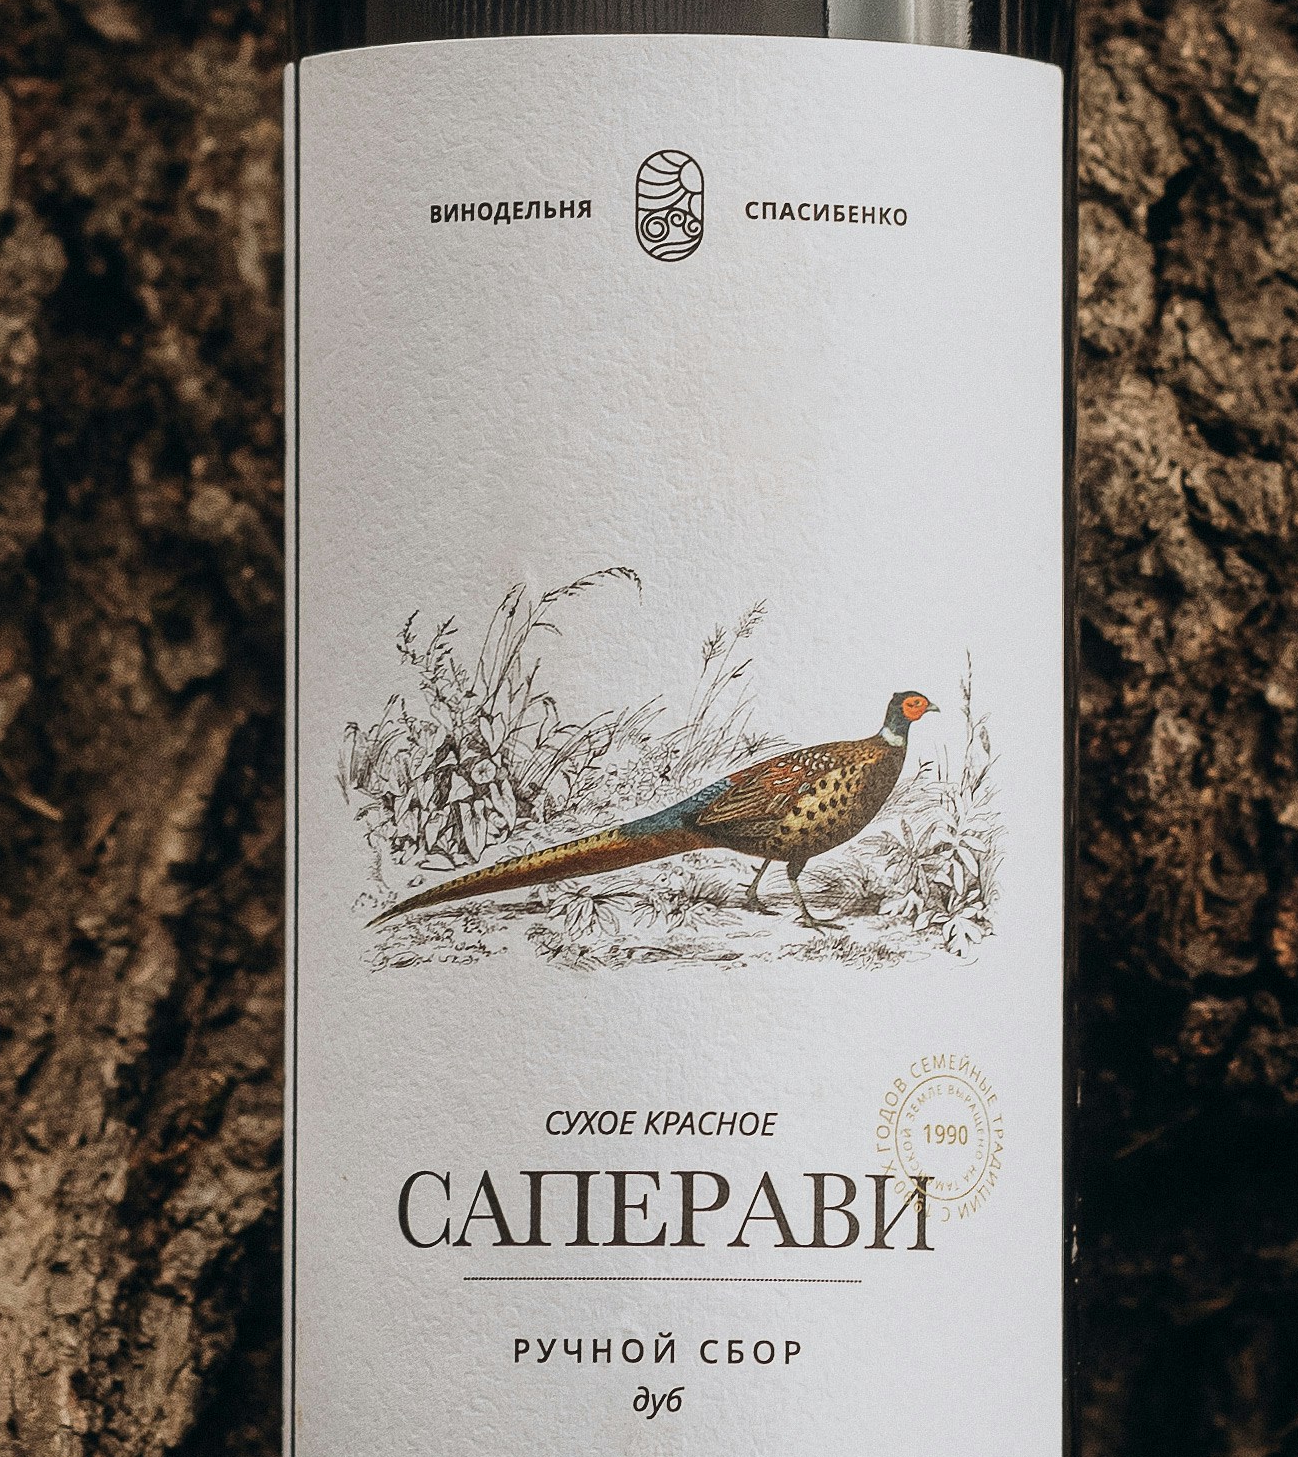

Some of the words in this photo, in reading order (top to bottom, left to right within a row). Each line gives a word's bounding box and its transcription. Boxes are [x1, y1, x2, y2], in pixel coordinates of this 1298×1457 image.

[430, 199, 592, 226] ВИНОДЕЛЬНЯ
[745, 201, 909, 227] СПАСИБЕНКО
[910, 1054, 998, 1108] СЕМЕЙНЫЕ
[545, 1110, 638, 1136] СУХОЕ
[643, 1110, 779, 1137] КРАСНОЕ
[876, 1078, 908, 1152] ГОДОВ
[924, 1124, 968, 1145] 1990
[957, 1114, 1004, 1219] ТРАДИЦИИ
[397, 1169, 936, 1252] САПЕРАВИ
[514, 1331, 676, 1364] РУЧНОЙ
[700, 1339, 802, 1365] СБОР
[632, 1385, 685, 1420] дуб
